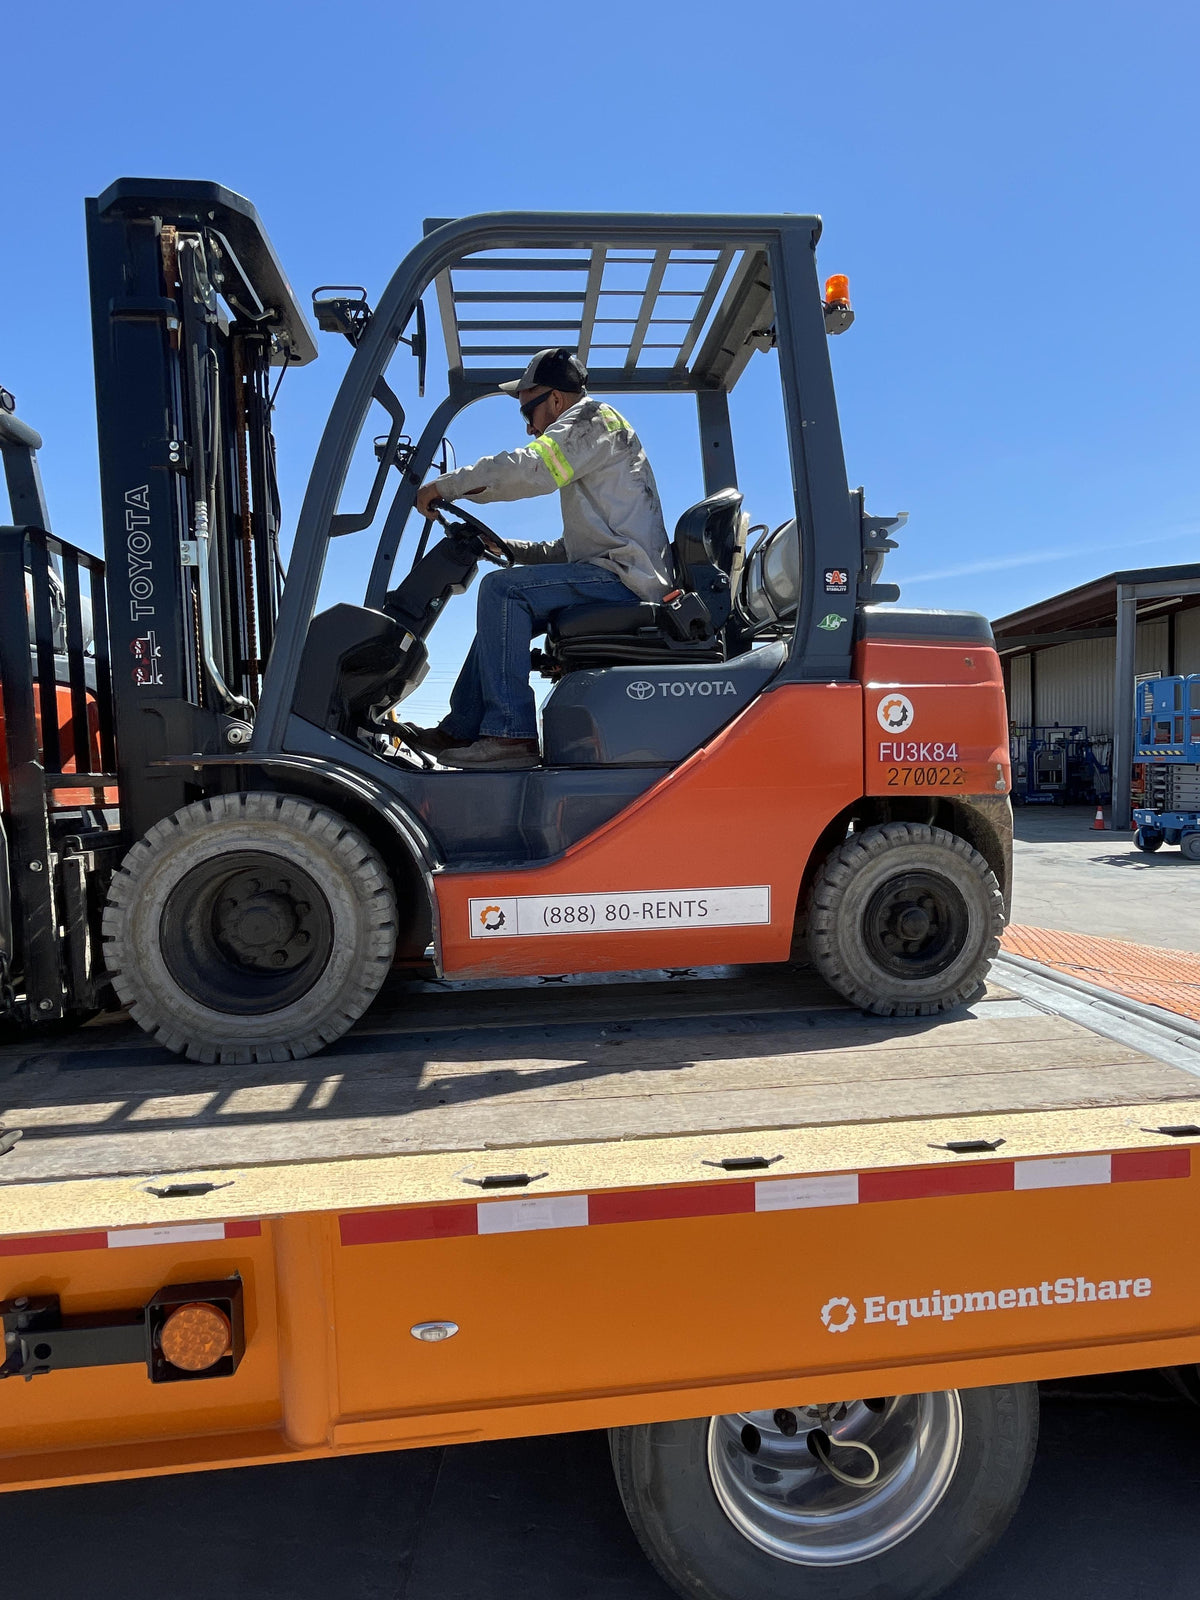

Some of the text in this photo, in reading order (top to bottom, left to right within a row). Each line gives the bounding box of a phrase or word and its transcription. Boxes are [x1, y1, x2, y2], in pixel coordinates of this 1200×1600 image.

[124, 484, 155, 622] TOYOTA
[825, 570, 848, 584] SAS
[658, 681, 738, 697] TOYOTA
[879, 742, 958, 762] FU3K84
[887, 767, 967, 786] 270022
[542, 899, 709, 926] (888) 80-RENTS
[863, 1277, 1152, 1326] EquipmentShare
